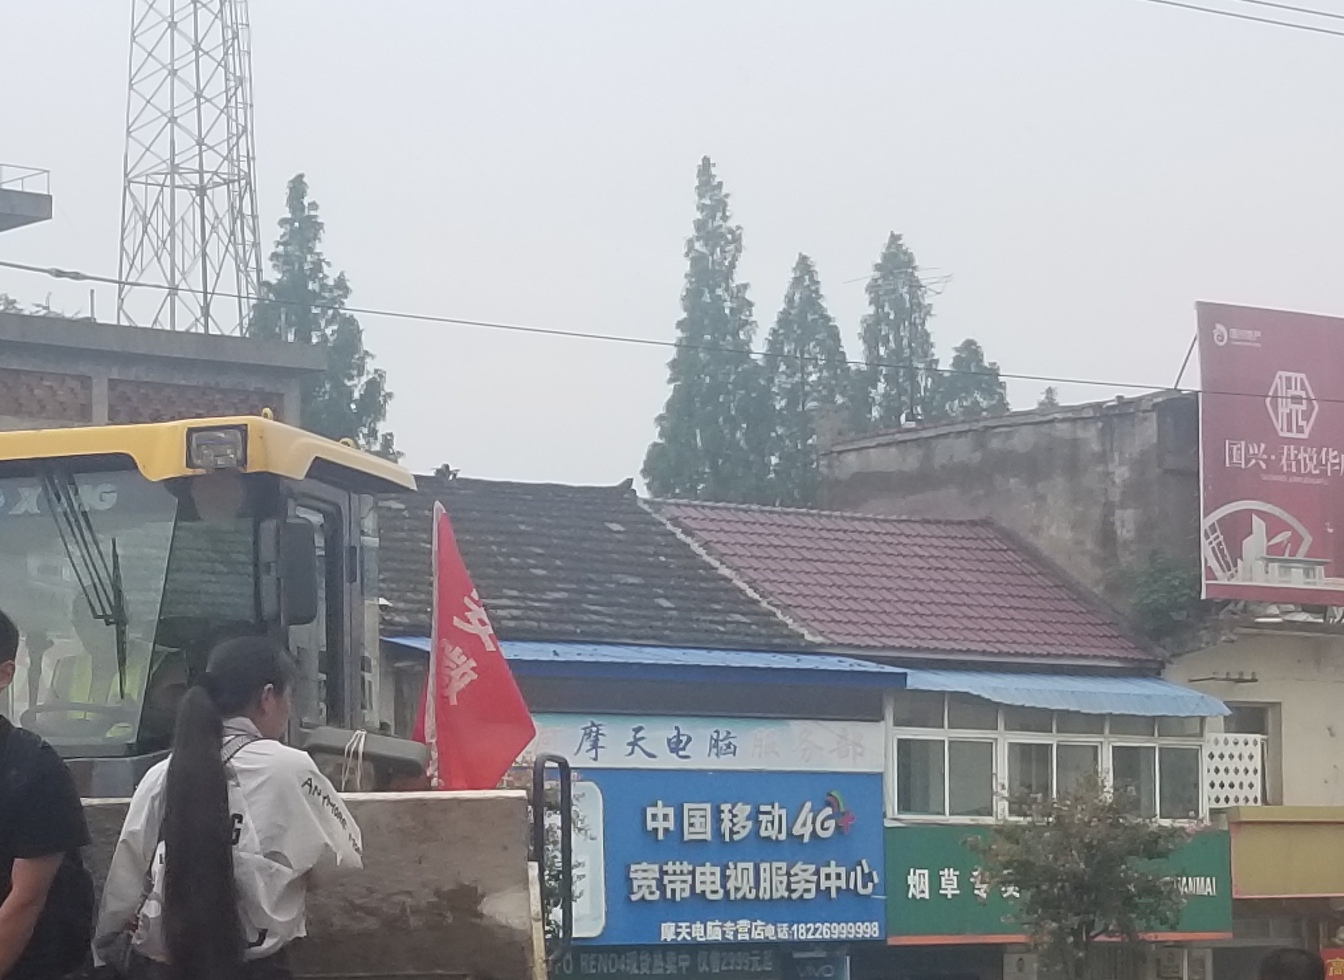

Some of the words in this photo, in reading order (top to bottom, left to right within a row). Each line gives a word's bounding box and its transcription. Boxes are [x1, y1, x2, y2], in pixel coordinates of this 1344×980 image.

[574, 720, 738, 762] 摩天电脑
[629, 858, 879, 901] 宽带电视服务中心
